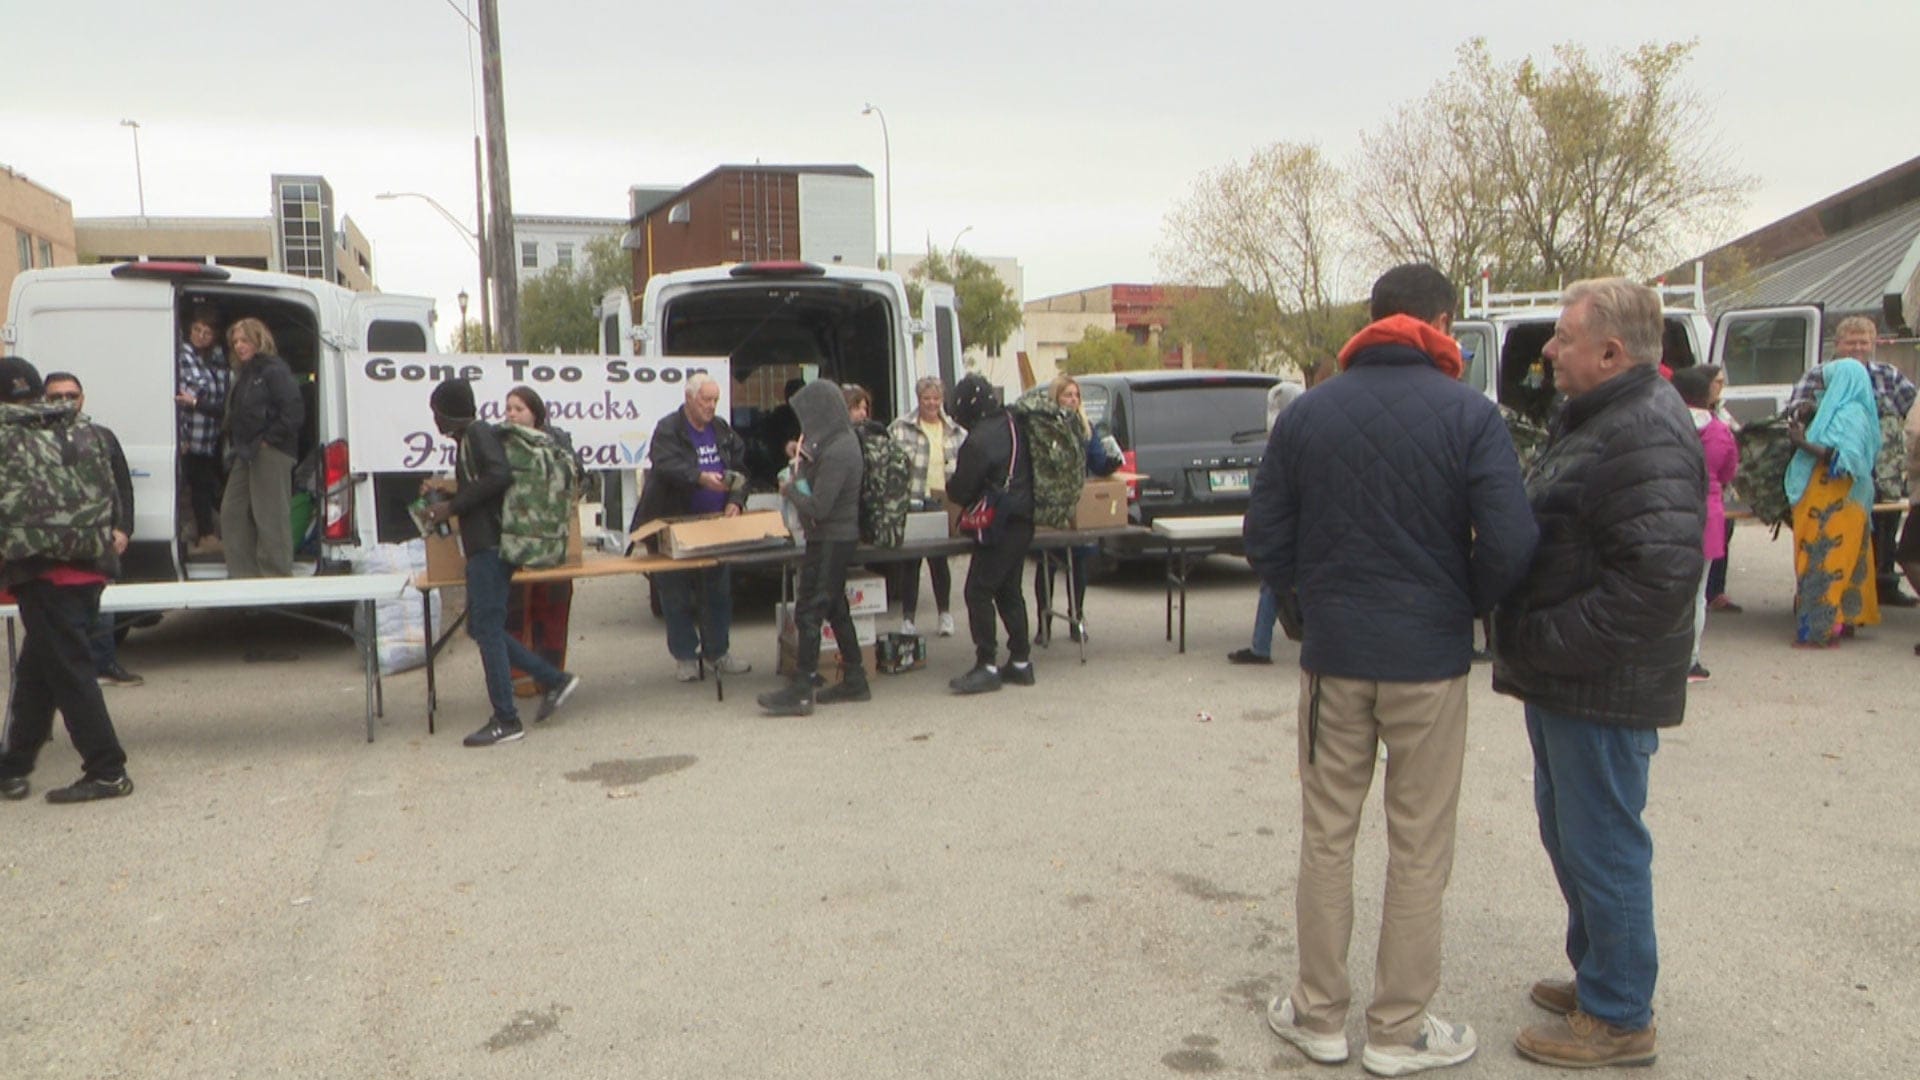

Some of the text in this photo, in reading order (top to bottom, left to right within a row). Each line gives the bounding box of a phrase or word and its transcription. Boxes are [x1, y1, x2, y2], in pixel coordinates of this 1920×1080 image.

[365, 358, 483, 381] Gone
[506, 359, 582, 382] Too
[479, 390, 640, 420] apacks
